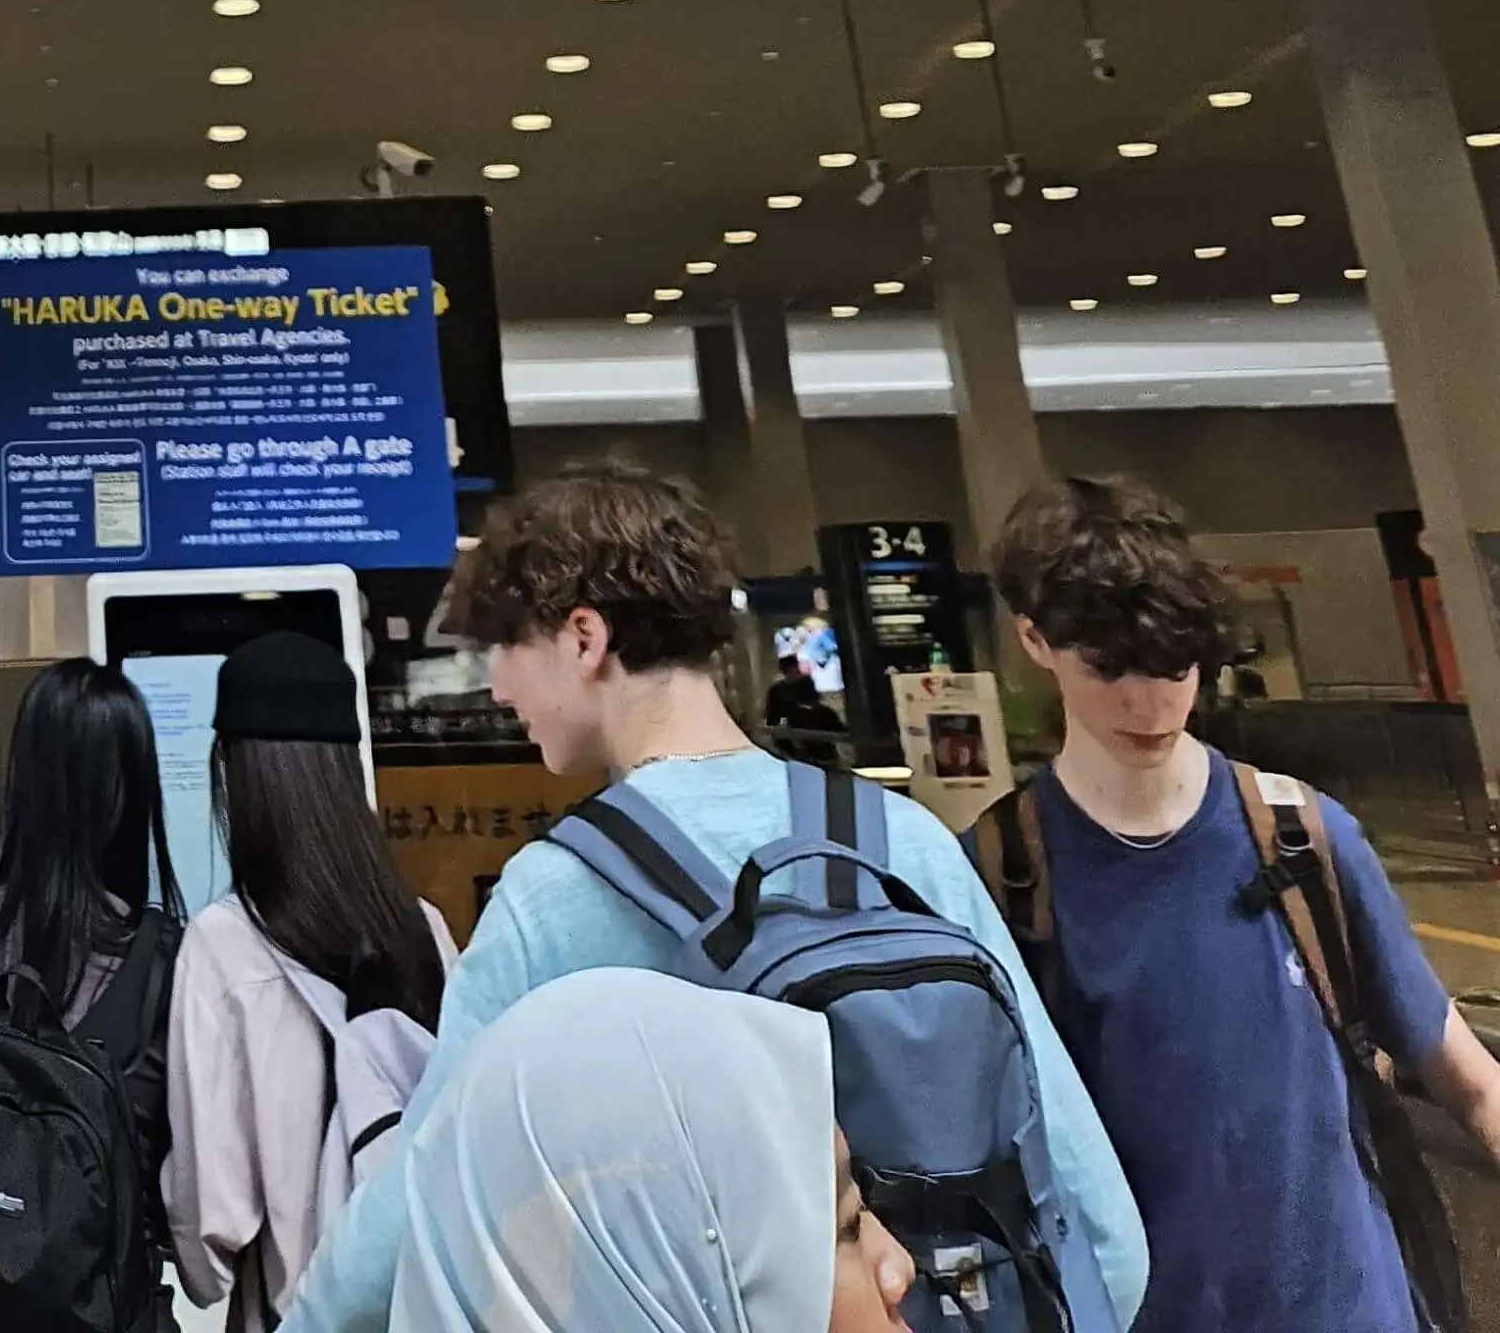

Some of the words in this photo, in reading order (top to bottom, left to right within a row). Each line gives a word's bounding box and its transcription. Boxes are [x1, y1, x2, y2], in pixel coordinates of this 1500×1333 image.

[136, 268, 171, 286] You
[174, 269, 206, 285] can
[208, 265, 290, 286] exchange
[1, 292, 150, 325] "HARUKA
[158, 290, 300, 326] One-way
[306, 284, 419, 317] Ticket"
[73, 330, 169, 357] purchased
[173, 332, 194, 348] at
[198, 328, 258, 348] Travel
[261, 325, 352, 351] Agencies.
[156, 439, 223, 461] Please
[227, 442, 255, 463] go
[257, 436, 339, 461] through
[342, 435, 362, 455] A
[364, 435, 414, 460] gate
